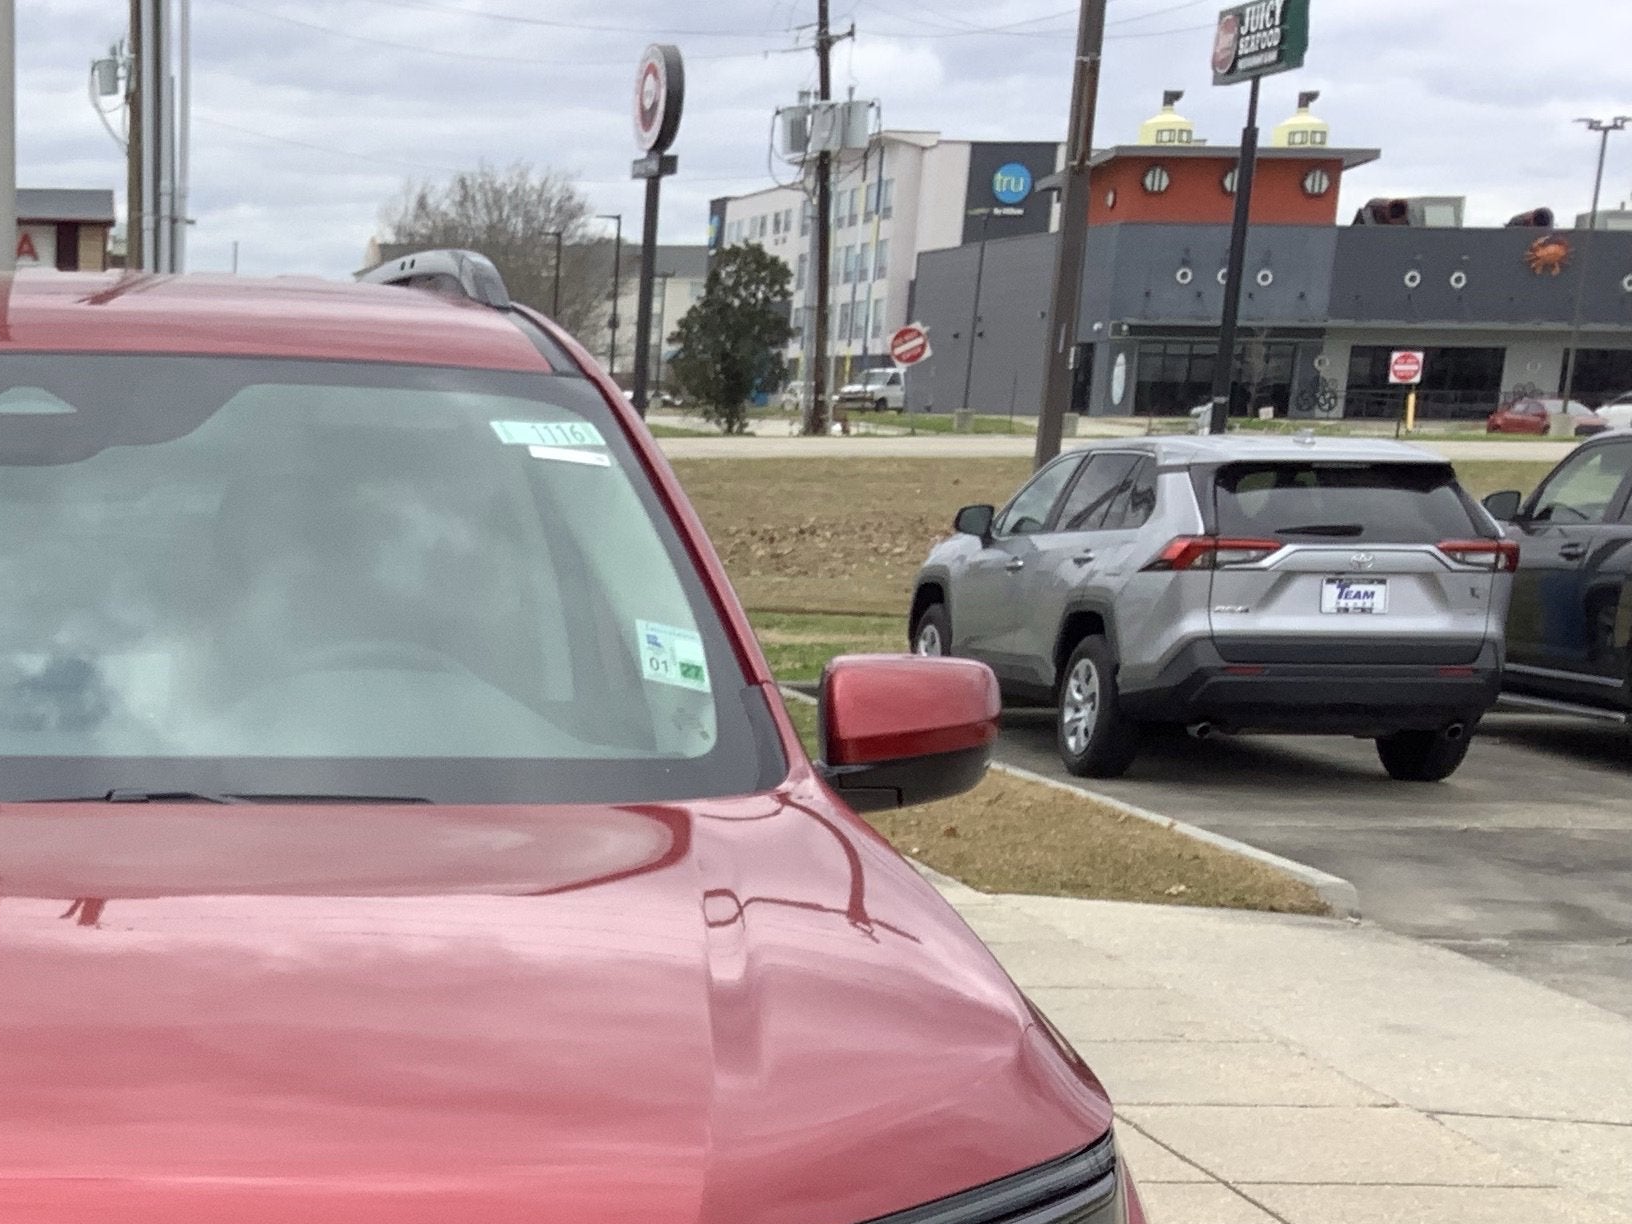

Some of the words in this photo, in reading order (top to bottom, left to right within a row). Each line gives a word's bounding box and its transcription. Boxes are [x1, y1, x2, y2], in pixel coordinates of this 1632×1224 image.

[1240, 0, 1285, 35] JUICY
[994, 172, 1024, 193] tru
[529, 424, 587, 444] 1116
[1336, 582, 1376, 600] TEAM
[649, 656, 669, 674] 01
